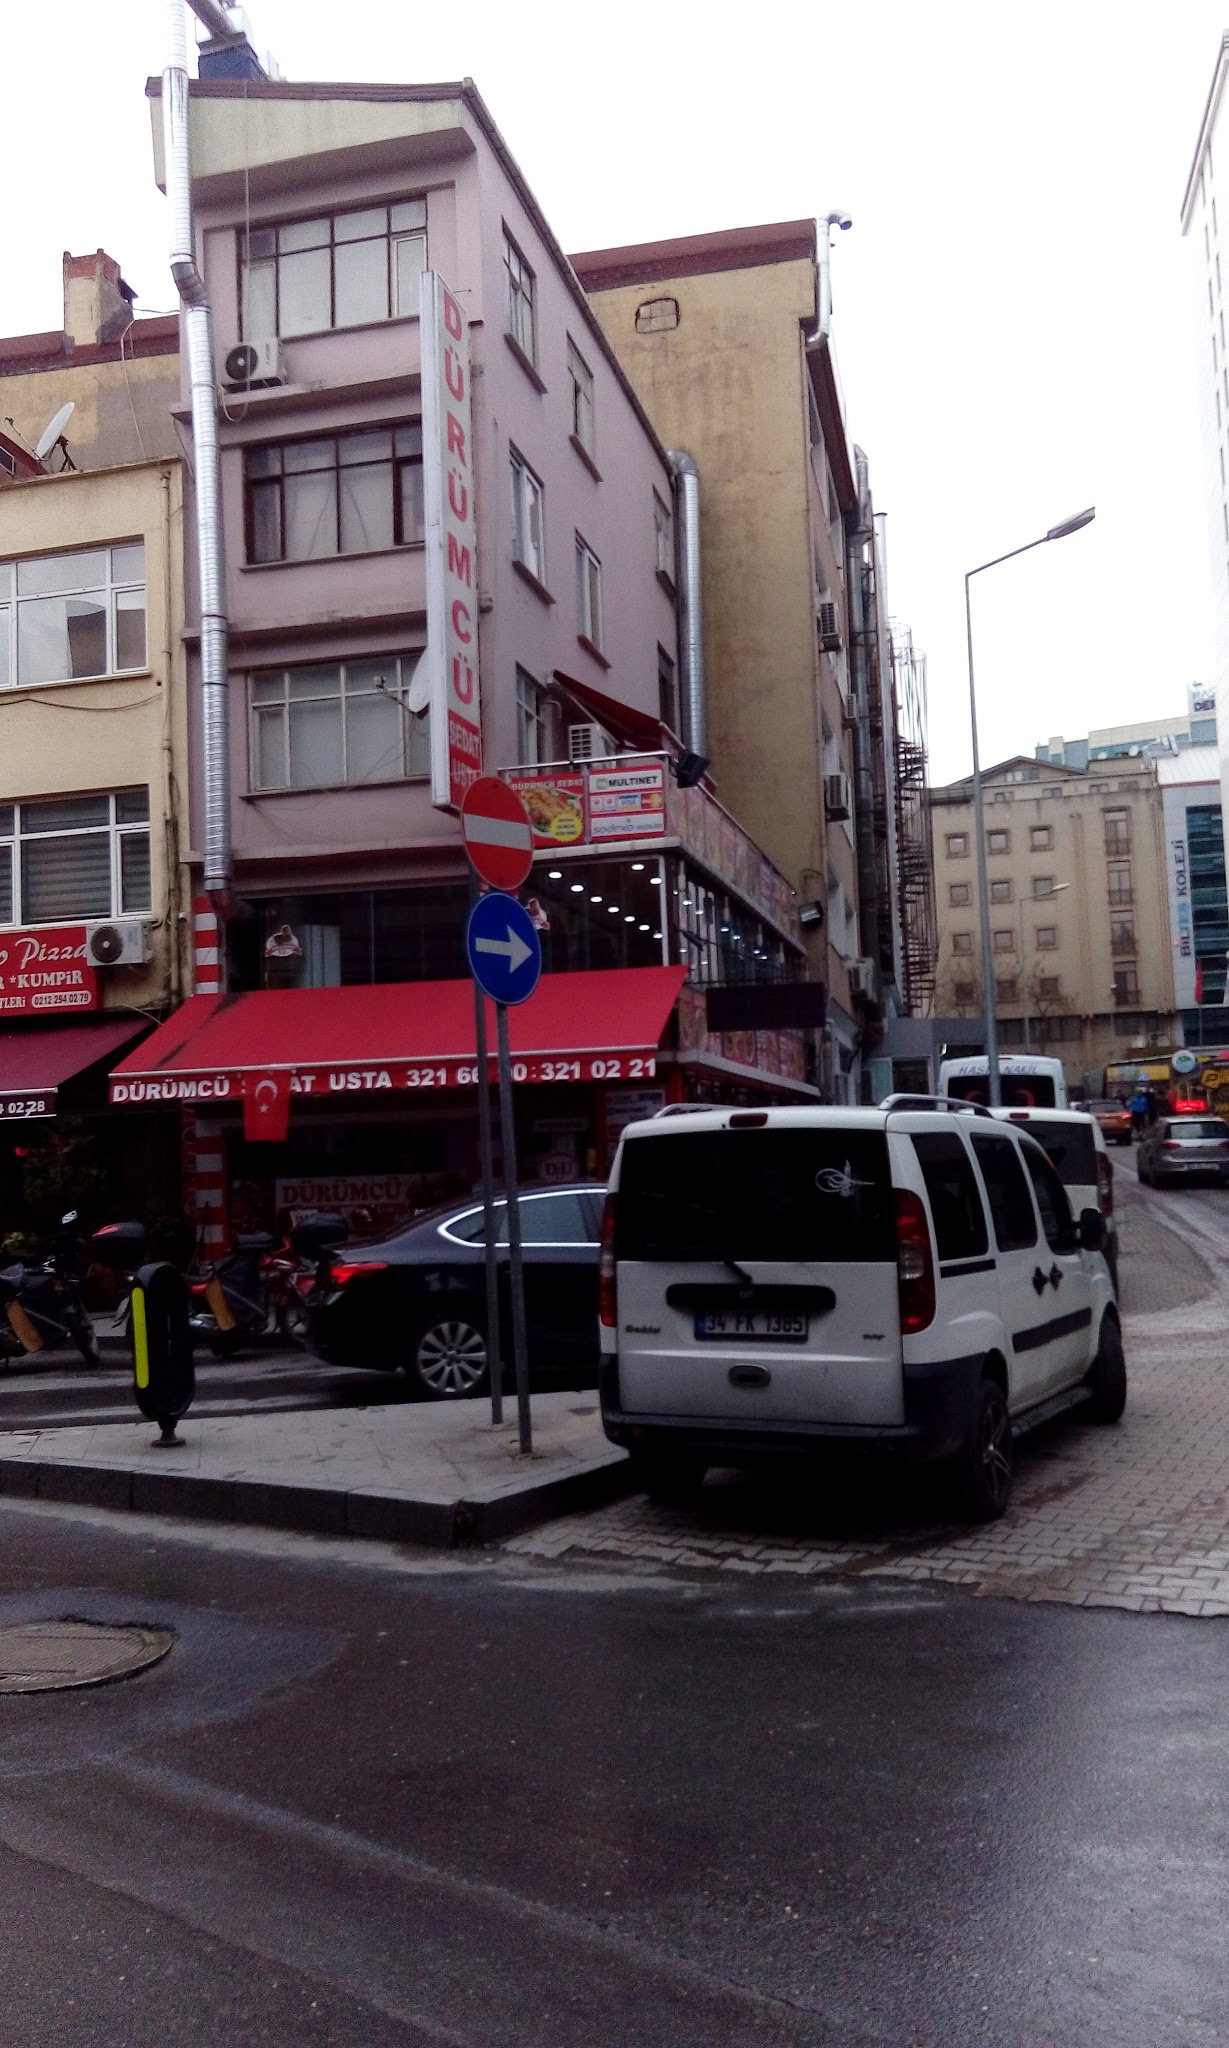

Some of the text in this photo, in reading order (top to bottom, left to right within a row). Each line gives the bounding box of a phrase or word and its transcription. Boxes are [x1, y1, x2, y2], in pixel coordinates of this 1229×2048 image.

[444, 290, 474, 706] DÜRÜMCÜ
[449, 720, 480, 760] SEDAT
[608, 776, 658, 787] MULTINET
[15, 937, 86, 969] Pizza
[34, 996, 53, 1006] 0212
[54, 995, 67, 1004] 294
[69, 993, 78, 1003] 02
[112, 1075, 230, 1103] DÜRÜMCÜ
[328, 1070, 393, 1091] USTA
[407, 1067, 447, 1087] 321
[540, 1061, 580, 1081] 321
[590, 1059, 621, 1079] 02
[628, 1058, 657, 1078] 21
[282, 1176, 402, 1204] DÜRÜMCÜ
[707, 1312, 726, 1331] 34
[735, 1312, 755, 1332] FK
